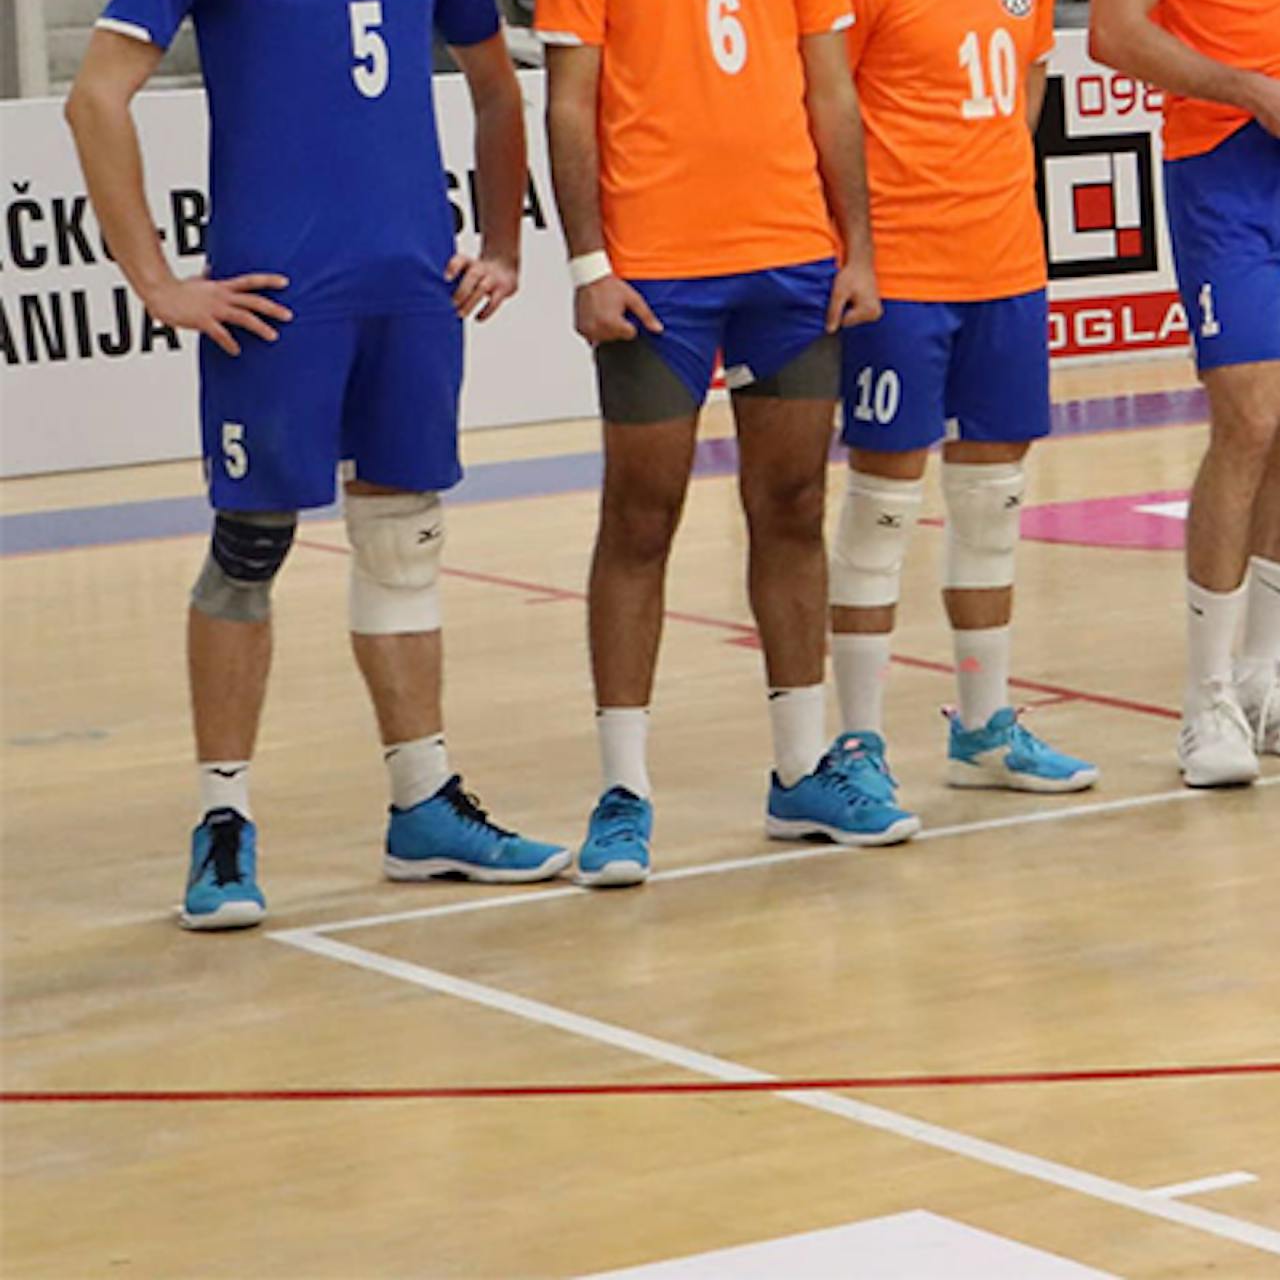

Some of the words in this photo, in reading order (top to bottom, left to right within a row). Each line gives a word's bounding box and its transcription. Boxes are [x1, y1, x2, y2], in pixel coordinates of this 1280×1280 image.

[957, 26, 1019, 120] 10
[1197, 282, 1222, 338] 1
[853, 366, 902, 425] 10
[220, 422, 248, 481] 5
